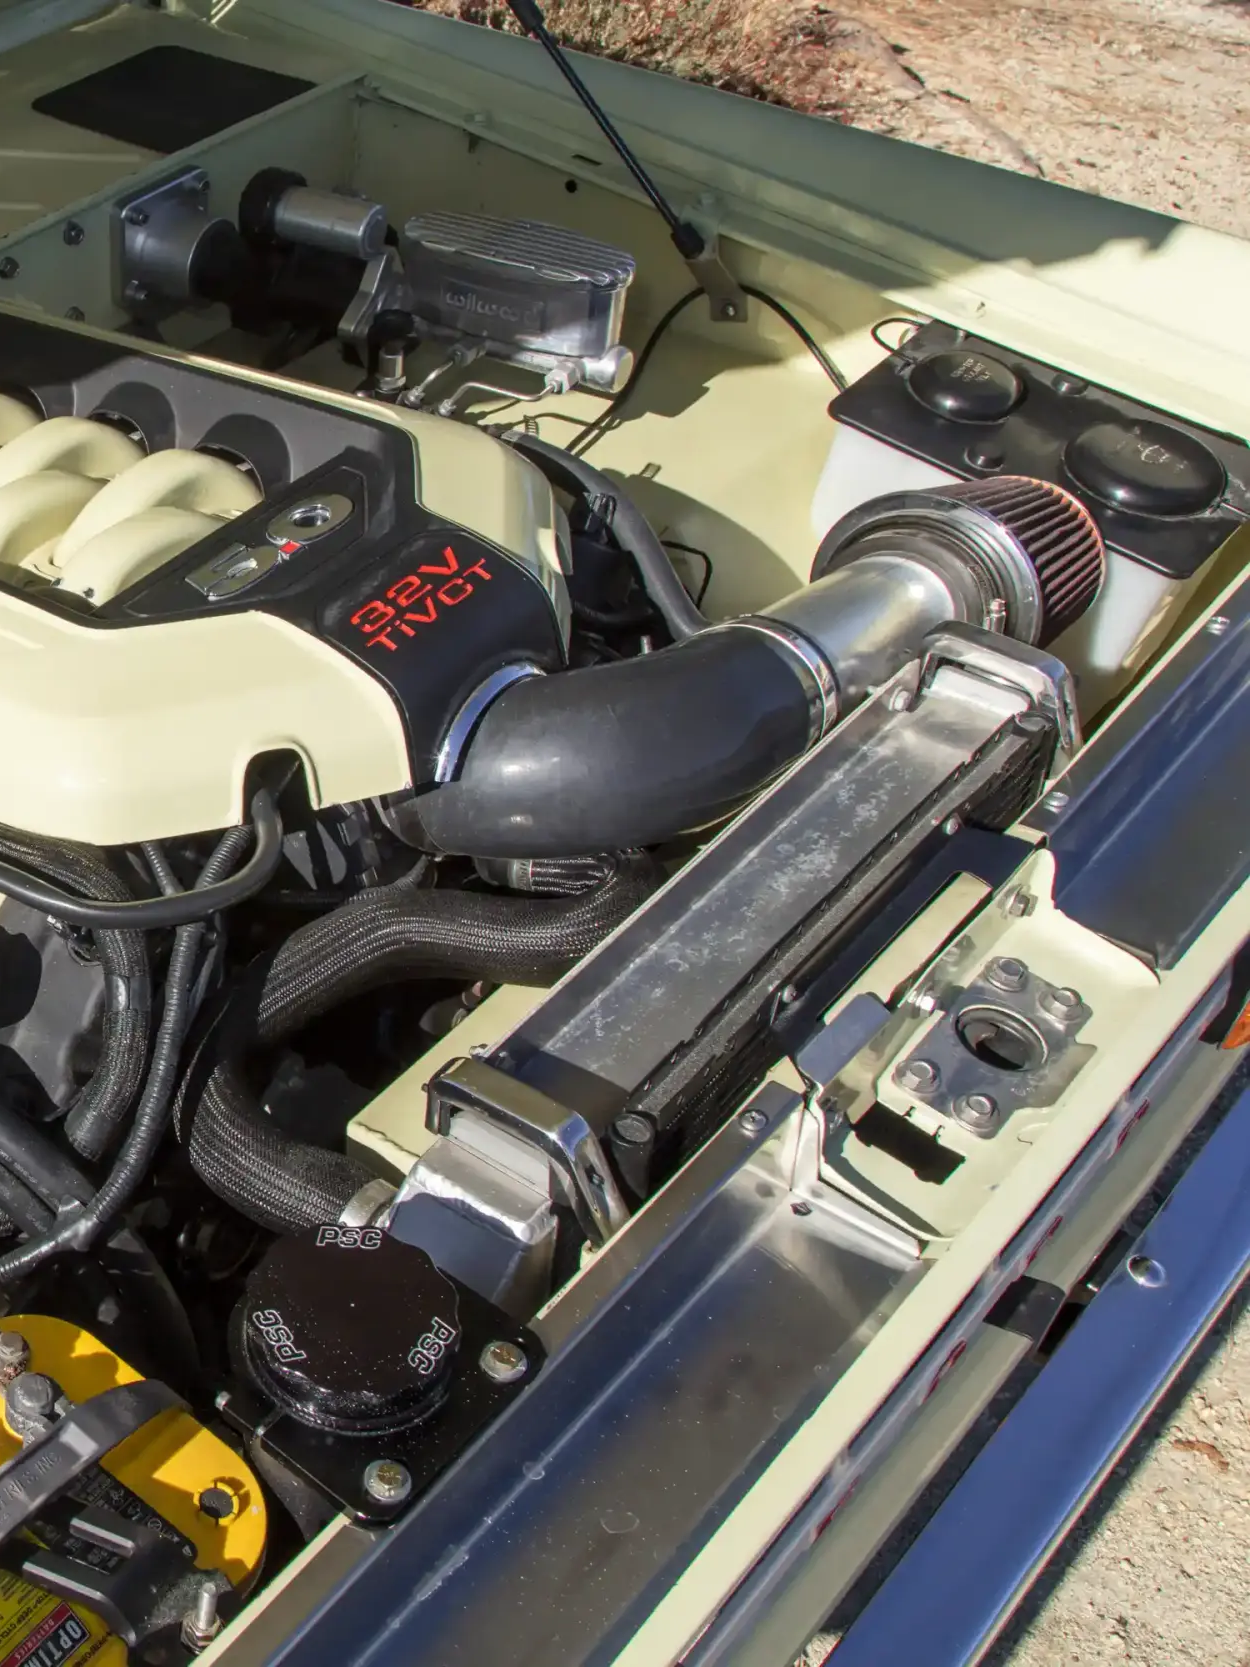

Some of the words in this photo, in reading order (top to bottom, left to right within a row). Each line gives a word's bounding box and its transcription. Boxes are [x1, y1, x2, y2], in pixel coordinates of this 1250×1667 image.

[351, 546, 459, 633] 32V
[316, 1226, 382, 1249] PSC
[252, 1309, 307, 1362] PSC
[408, 1316, 456, 1374] PSC
